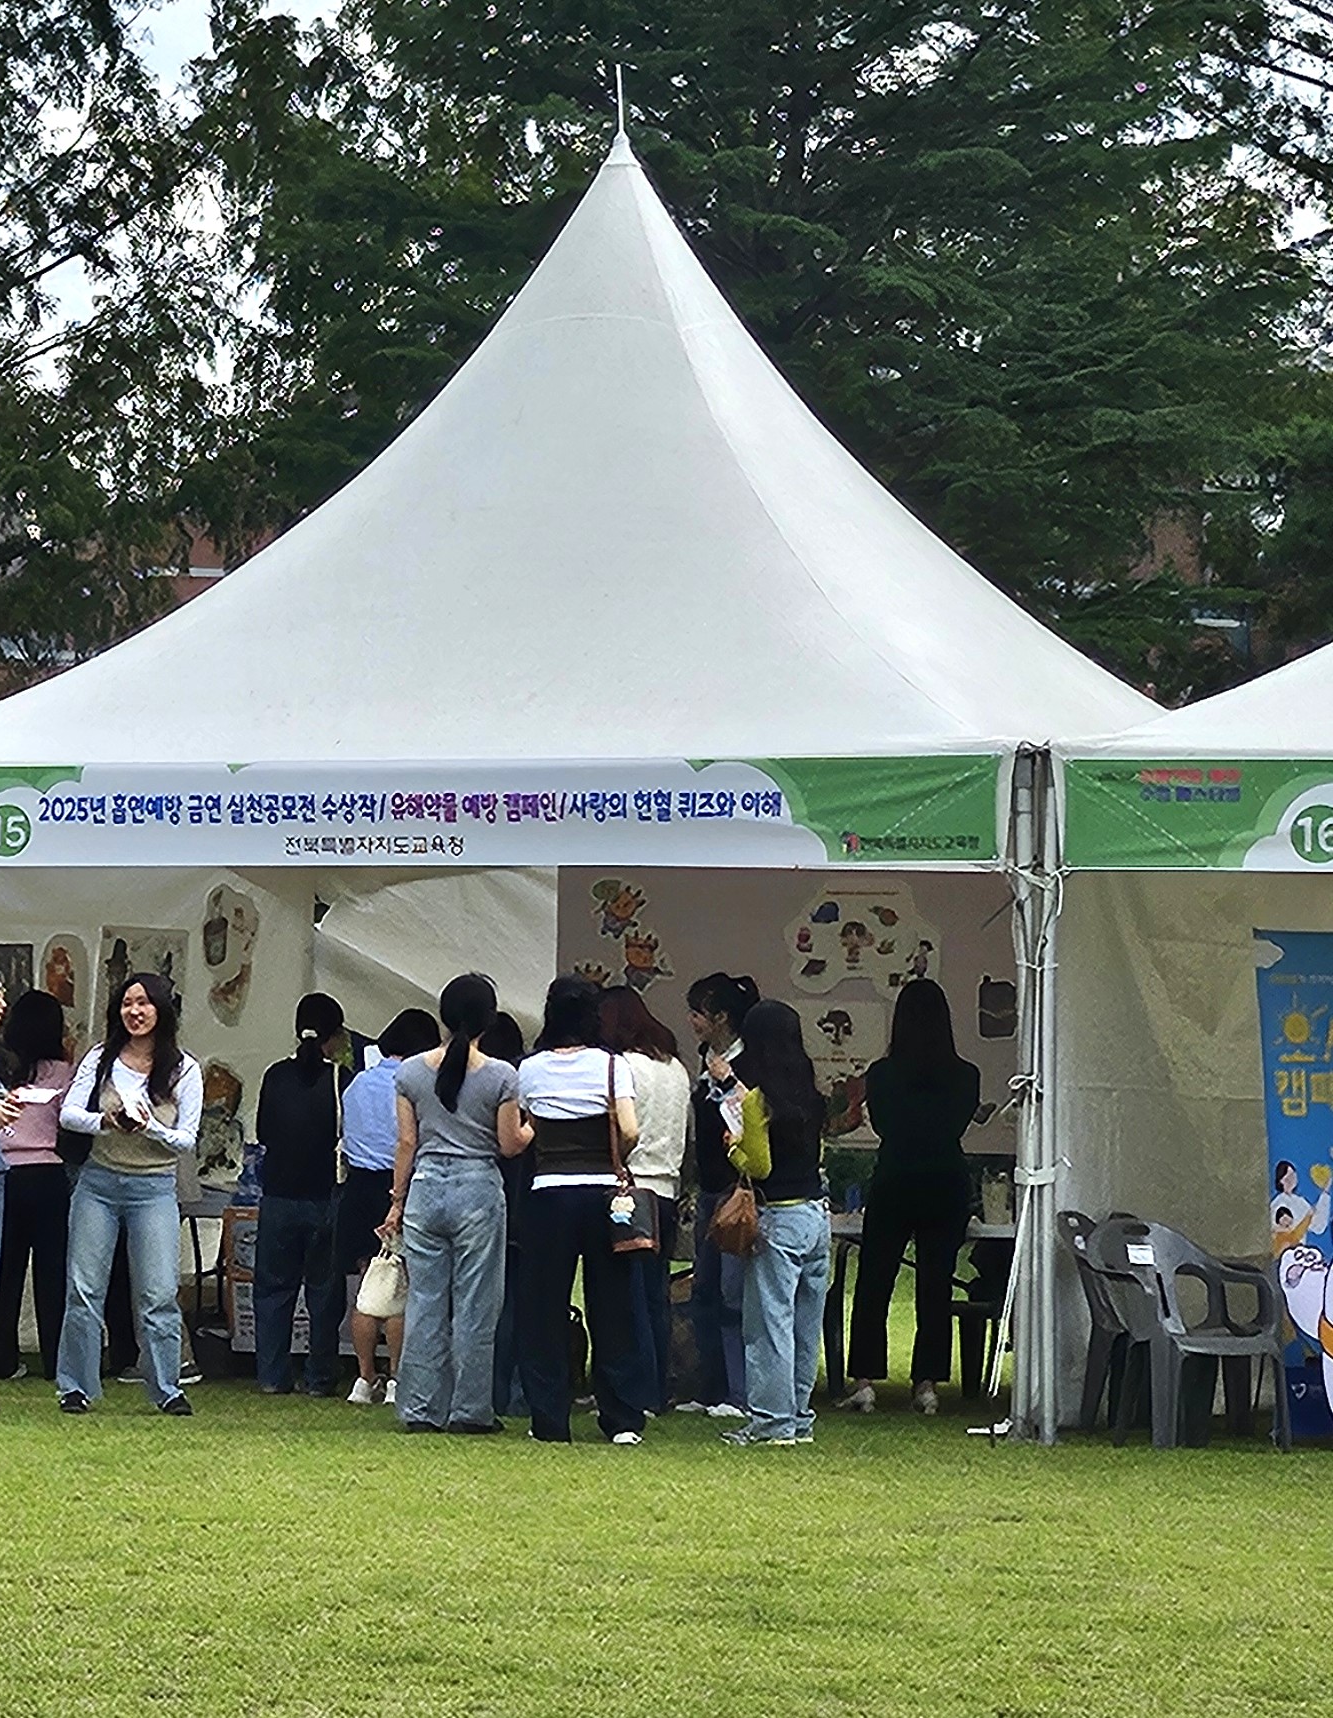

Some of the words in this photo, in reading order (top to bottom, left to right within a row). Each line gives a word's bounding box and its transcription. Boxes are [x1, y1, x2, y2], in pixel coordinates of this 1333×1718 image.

[38, 795, 106, 825] 2025년
[111, 792, 183, 826] 흡연예방
[187, 794, 223, 825] 금연
[226, 792, 317, 825] 실천공모전
[390, 792, 458, 824] 유해약물
[461, 792, 499, 825] 예방
[633, 790, 673, 823] 헌혈
[678, 790, 737, 819] 퀴즈와
[741, 790, 783, 819] 이해
[284, 835, 465, 858] 전북특별자치도교육청
